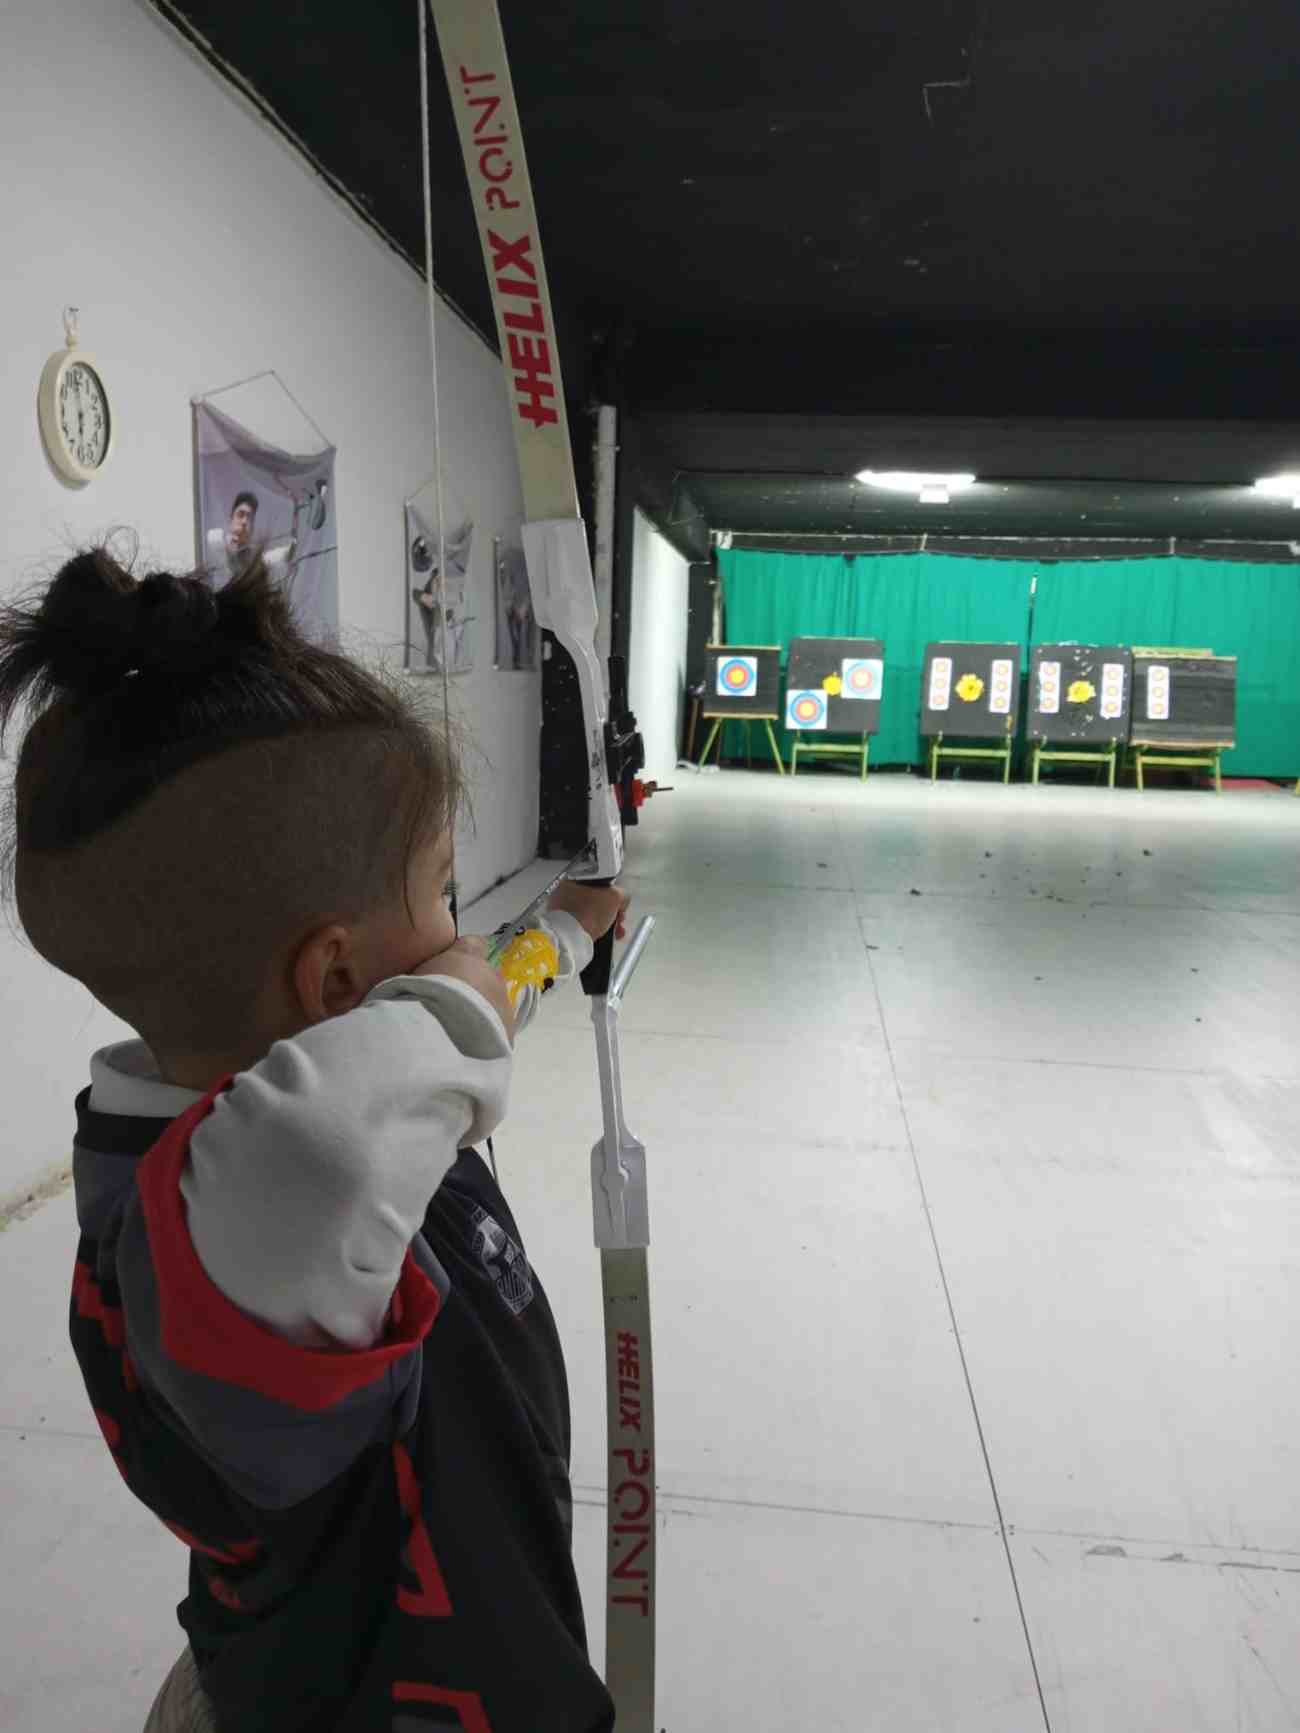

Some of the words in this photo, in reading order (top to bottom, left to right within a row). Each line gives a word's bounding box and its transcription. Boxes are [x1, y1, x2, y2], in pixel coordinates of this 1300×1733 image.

[460, 65, 520, 211] POINT
[487, 229, 559, 428] HELIX
[617, 1330, 641, 1432] HELIX
[612, 1448, 651, 1616] POINT
